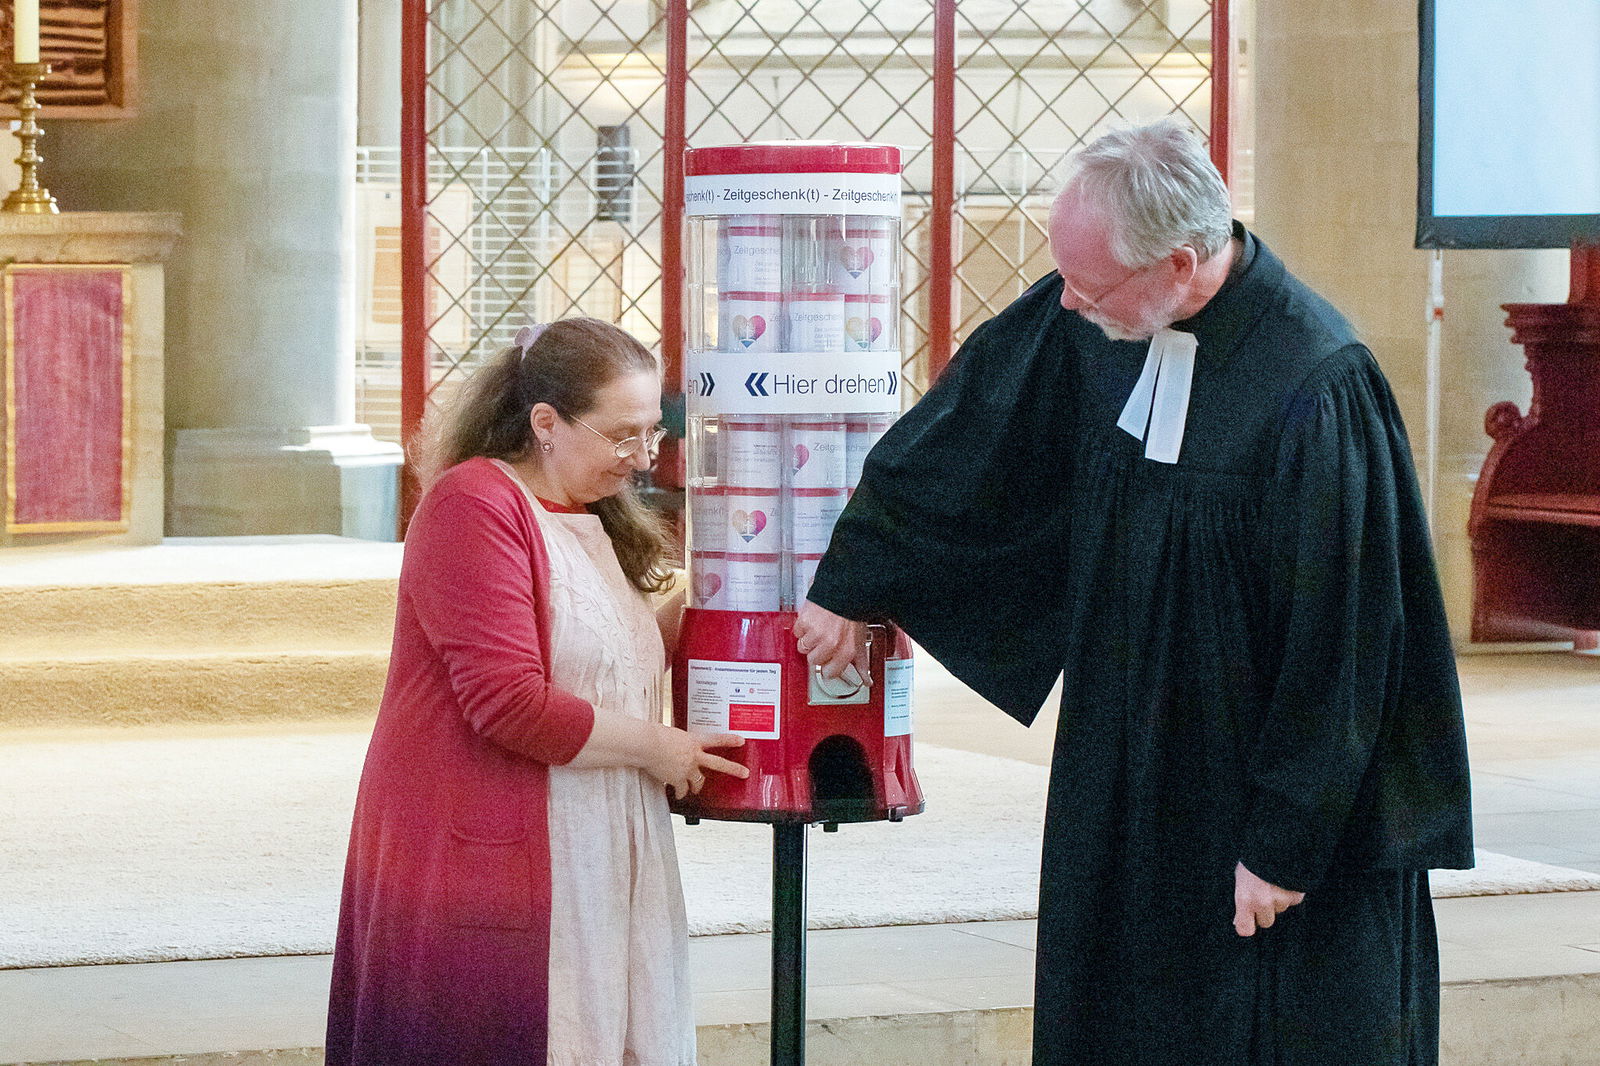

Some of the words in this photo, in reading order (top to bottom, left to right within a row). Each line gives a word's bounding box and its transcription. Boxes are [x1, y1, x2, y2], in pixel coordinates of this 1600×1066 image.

[723, 187, 820, 203] Zeitgeschenk(t)
[774, 374, 818, 395] Hier
[825, 374, 886, 395] drehen
